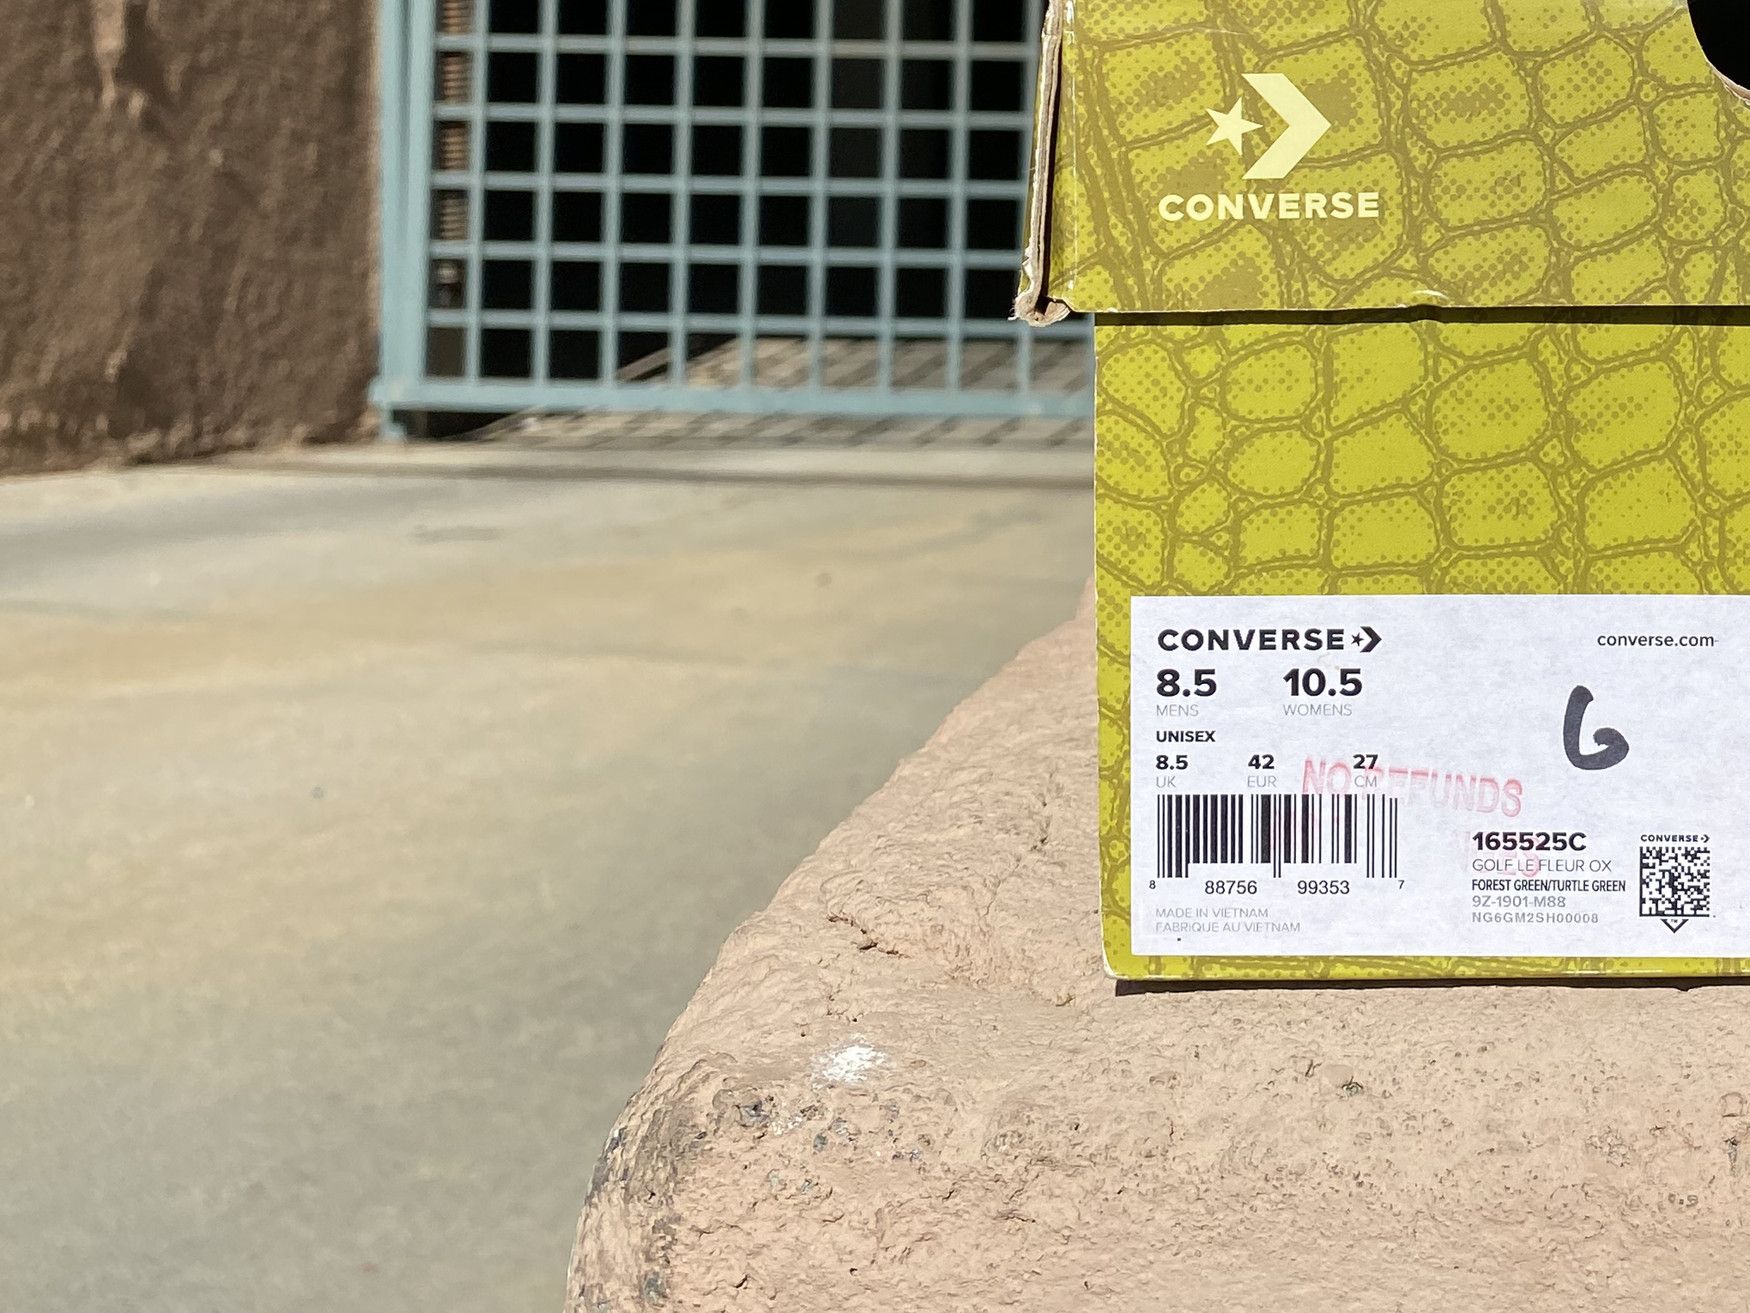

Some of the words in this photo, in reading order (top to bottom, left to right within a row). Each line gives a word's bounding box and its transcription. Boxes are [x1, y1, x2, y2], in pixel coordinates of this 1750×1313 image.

[1157, 190, 1380, 222] CONVERSE
[1157, 628, 1345, 651] CONVERSE
[1596, 634, 1715, 647] converse.com
[1155, 668, 1218, 697] 8.5
[1282, 668, 1363, 697] 10.5
[1155, 704, 1200, 717] MENS
[1282, 703, 1353, 717] WOMENS
[1155, 730, 1216, 743] UNISEX
[1155, 754, 1189, 770] 8.5
[1247, 754, 1275, 770] 42
[1352, 754, 1379, 770] 27
[1155, 775, 1177, 788] UK
[1247, 775, 1277, 788] EUR
[1353, 775, 1378, 788] CM
[1301, 755, 1352, 796] NO
[1472, 831, 1587, 851] 165525C
[1640, 834, 1699, 843] CONVERSE
[1472, 858, 1514, 872] GOLF
[1517, 858, 1537, 872] LE
[1538, 858, 1585, 872] FLEUR
[1589, 858, 1612, 872] OX
[1148, 880, 1157, 890] 8
[1204, 880, 1258, 895] 88756
[1296, 880, 1350, 895] 99353
[1397, 880, 1405, 890] 7
[1471, 878, 1512, 892] FOREST
[1514, 878, 1590, 892] GREEN/TURTLE
[1592, 878, 1626, 892] GREEN
[1472, 894, 1567, 908] 9Z-1901-M88
[1155, 908, 1192, 919] MADE
[1196, 908, 1209, 919] IN
[1213, 908, 1270, 919] VIETNAM
[1155, 921, 1221, 934] FABRIQUE
[1223, 921, 1241, 933] AU
[1243, 921, 1302, 933] VIETNAM
